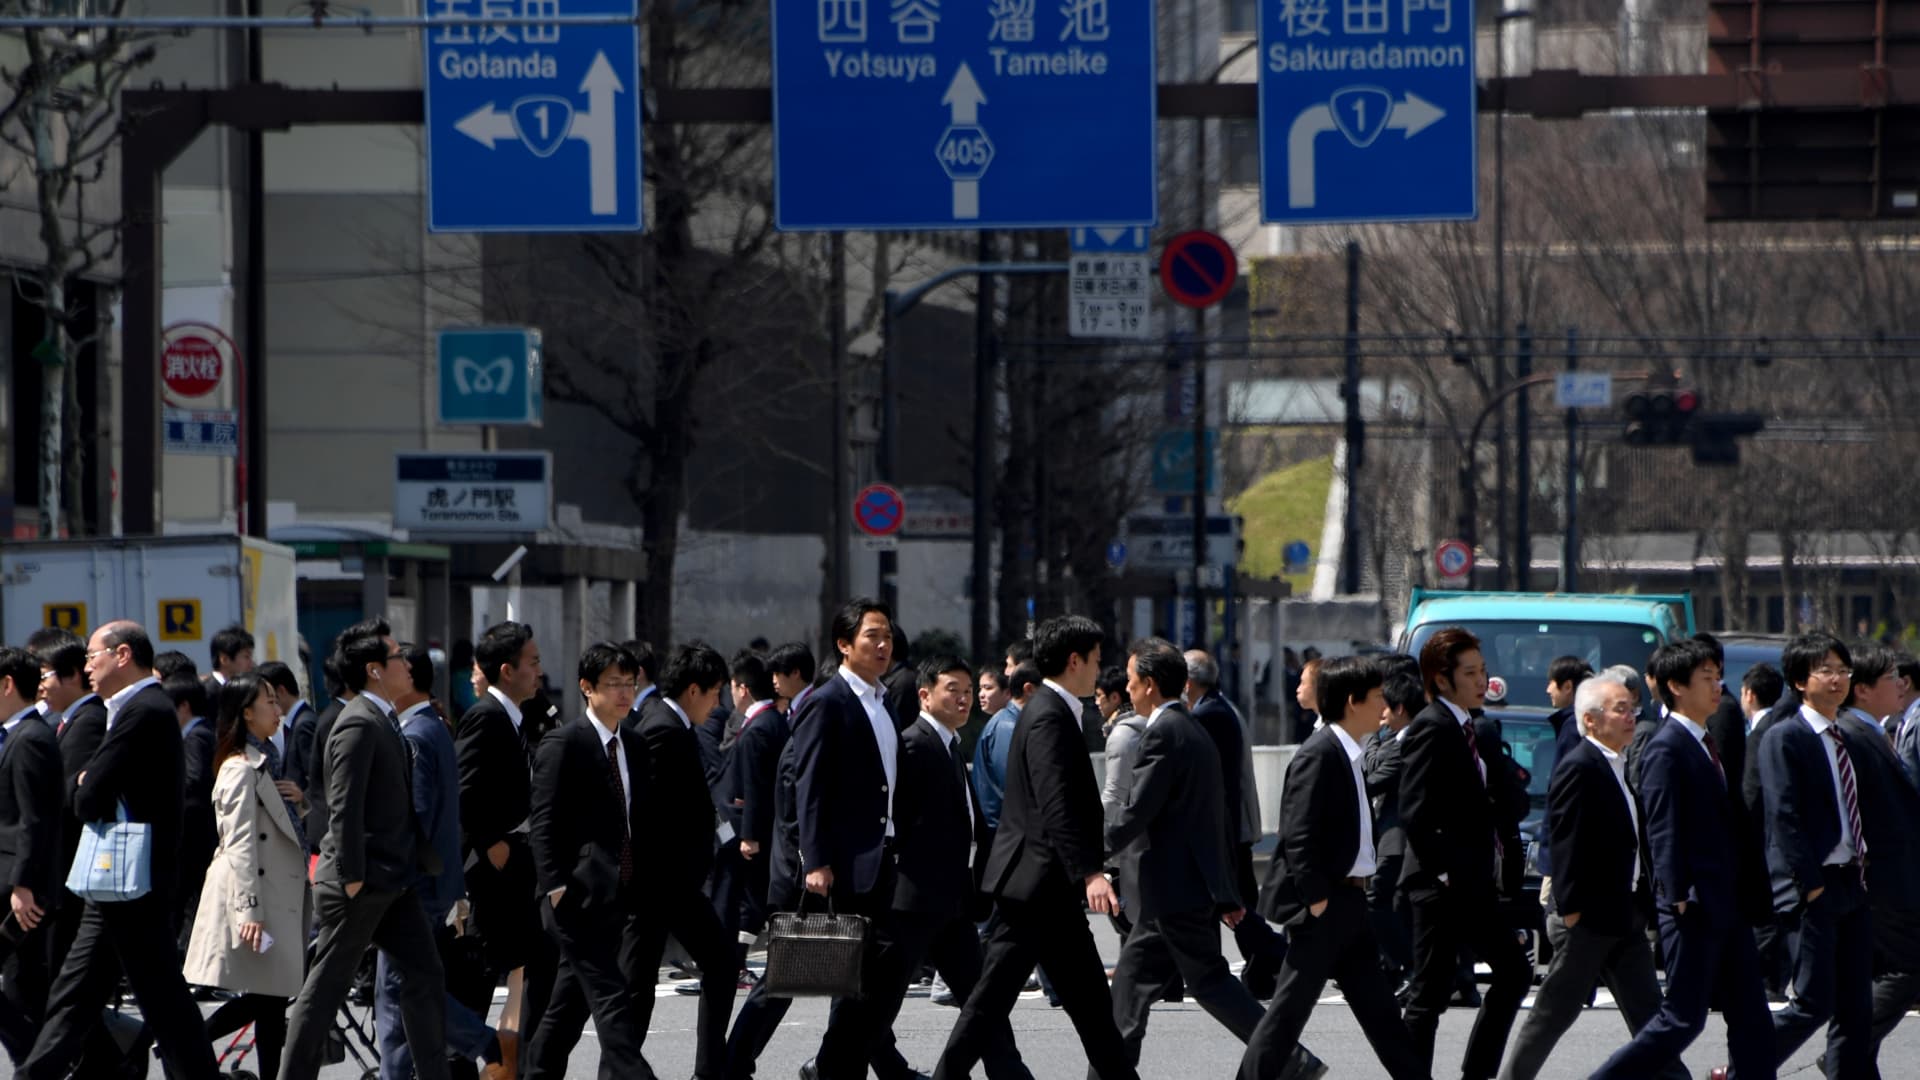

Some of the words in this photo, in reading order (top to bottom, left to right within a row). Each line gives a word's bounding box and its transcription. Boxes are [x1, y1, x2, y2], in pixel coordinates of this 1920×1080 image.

[817, 0, 941, 43] 四谷
[1278, 0, 1452, 38] 桜田門
[438, 49, 557, 79] Gotanda
[824, 49, 937, 82] Yotsuya
[988, 47, 1108, 77] Tameike
[1268, 41, 1465, 73] Sakuradamon
[532, 104, 549, 140] 1
[1351, 98, 1366, 132] 1
[943, 138, 987, 166] 405
[166, 354, 219, 380] 消火栓
[427, 487, 515, 508] 虎ノ門駅
